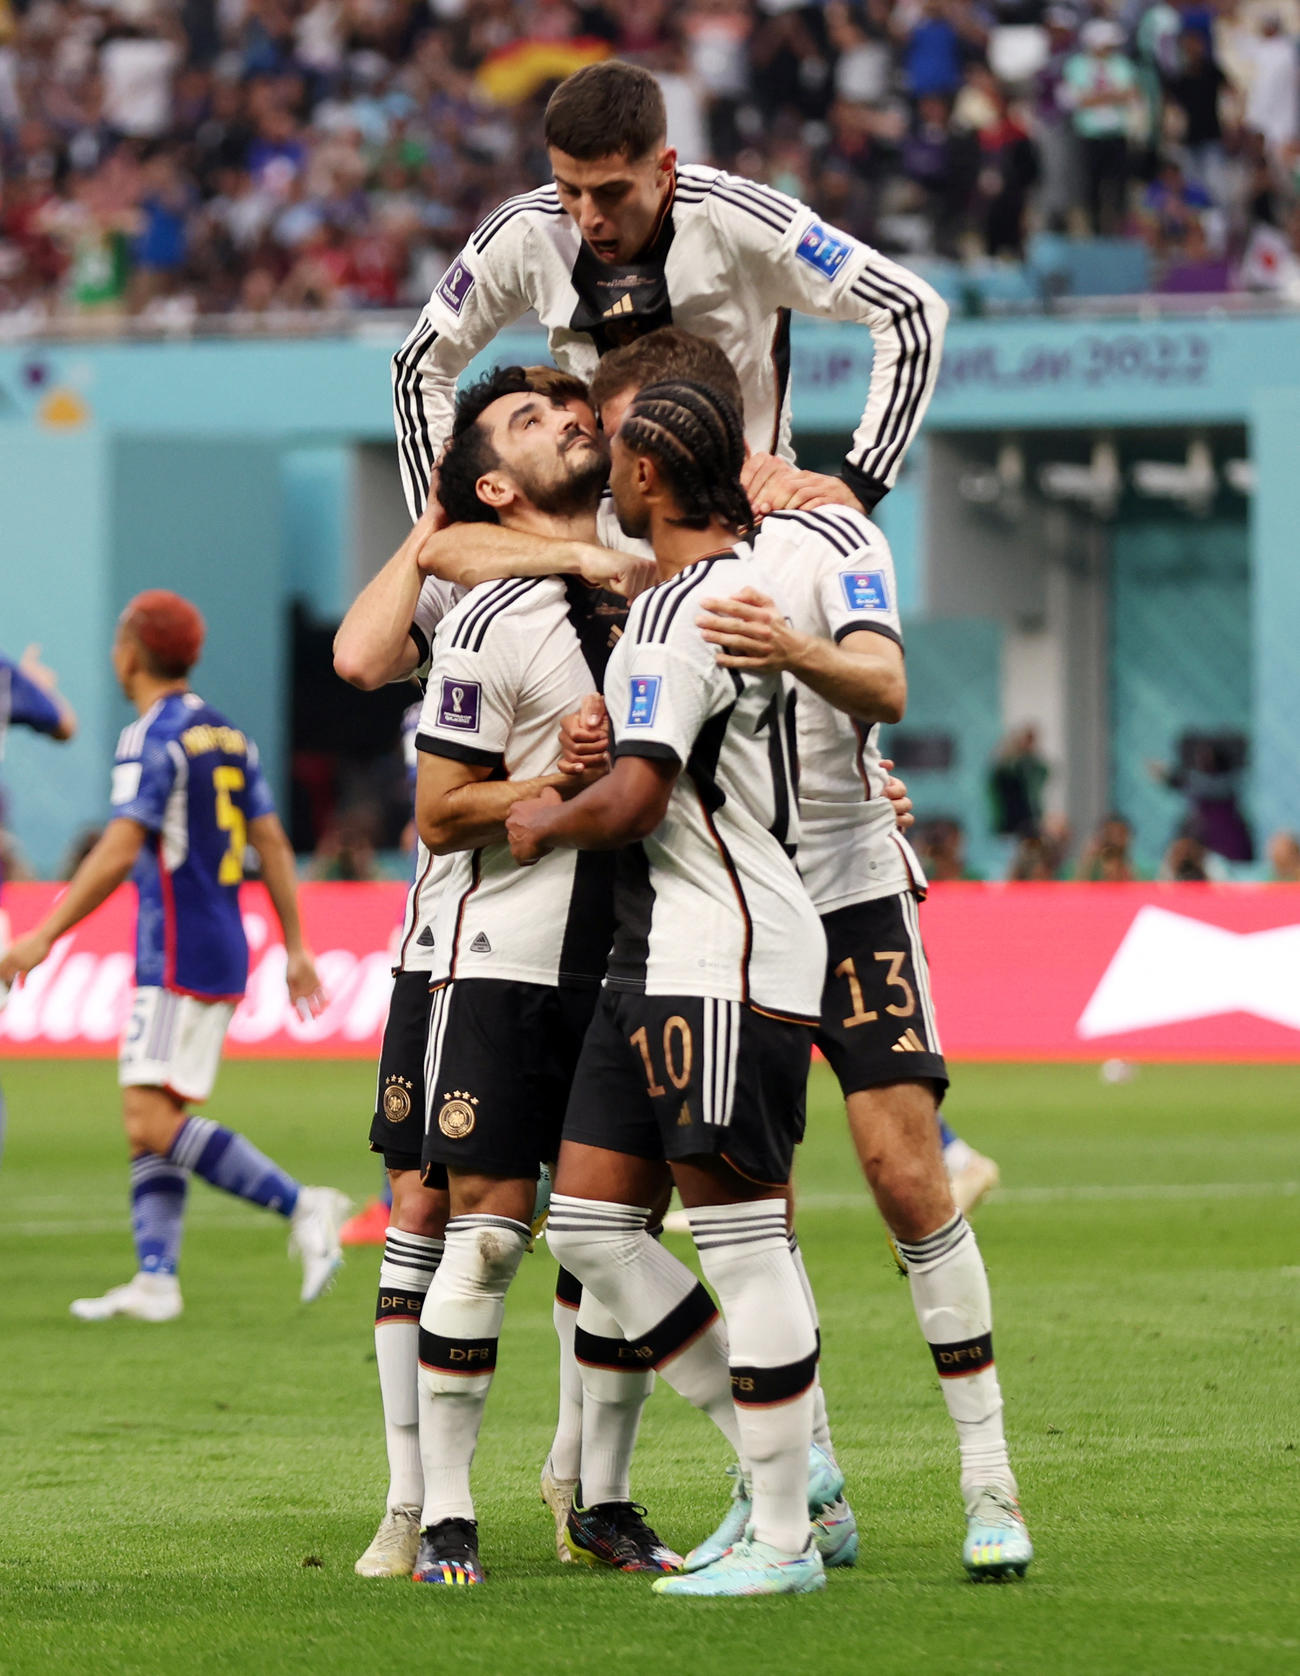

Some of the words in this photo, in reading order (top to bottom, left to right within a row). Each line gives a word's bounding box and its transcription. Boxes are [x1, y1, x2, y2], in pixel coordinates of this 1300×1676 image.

[212, 765, 247, 886] 5
[835, 951, 916, 1029] 13
[629, 1015, 693, 1098] 10
[381, 1296, 422, 1311] DFB
[448, 1347, 490, 1362] DFB
[939, 1346, 983, 1364] DFB
